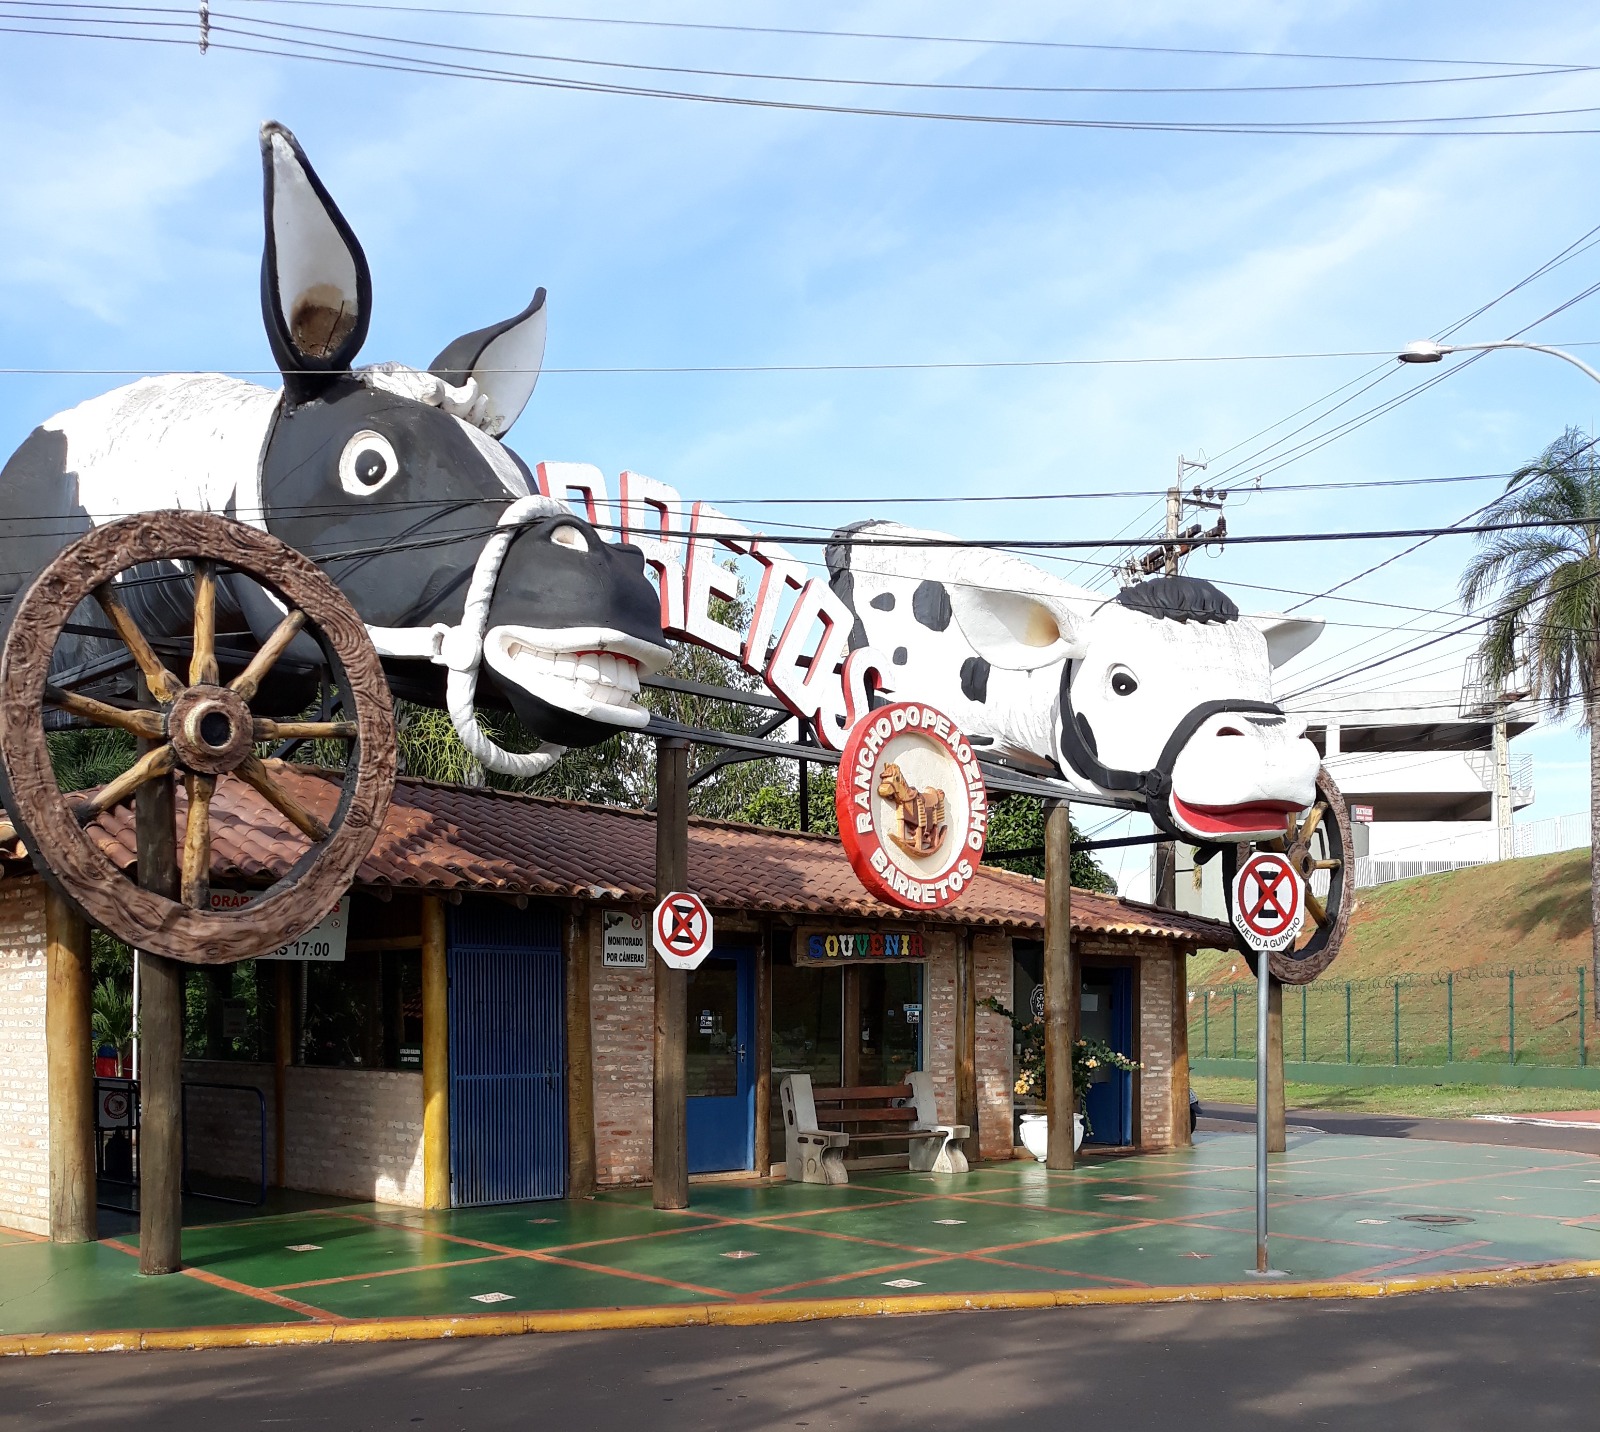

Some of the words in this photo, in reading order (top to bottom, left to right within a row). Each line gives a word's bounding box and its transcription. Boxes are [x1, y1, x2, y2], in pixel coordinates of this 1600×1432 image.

[854, 718, 892, 834] RANCHO
[890, 705, 921, 732] DO
[921, 708, 986, 850] PEÃOZINHO
[869, 847, 974, 903] BARRETOS
[608, 936, 643, 946] MONITORADO
[1235, 913, 1262, 946] SUJEITO
[1263, 939, 1269, 949] A
[1269, 917, 1301, 949] GUINCHO
[294, 941, 330, 957] 17:00
[808, 934, 925, 957] SOUVENIR
[607, 953, 617, 962] POR
